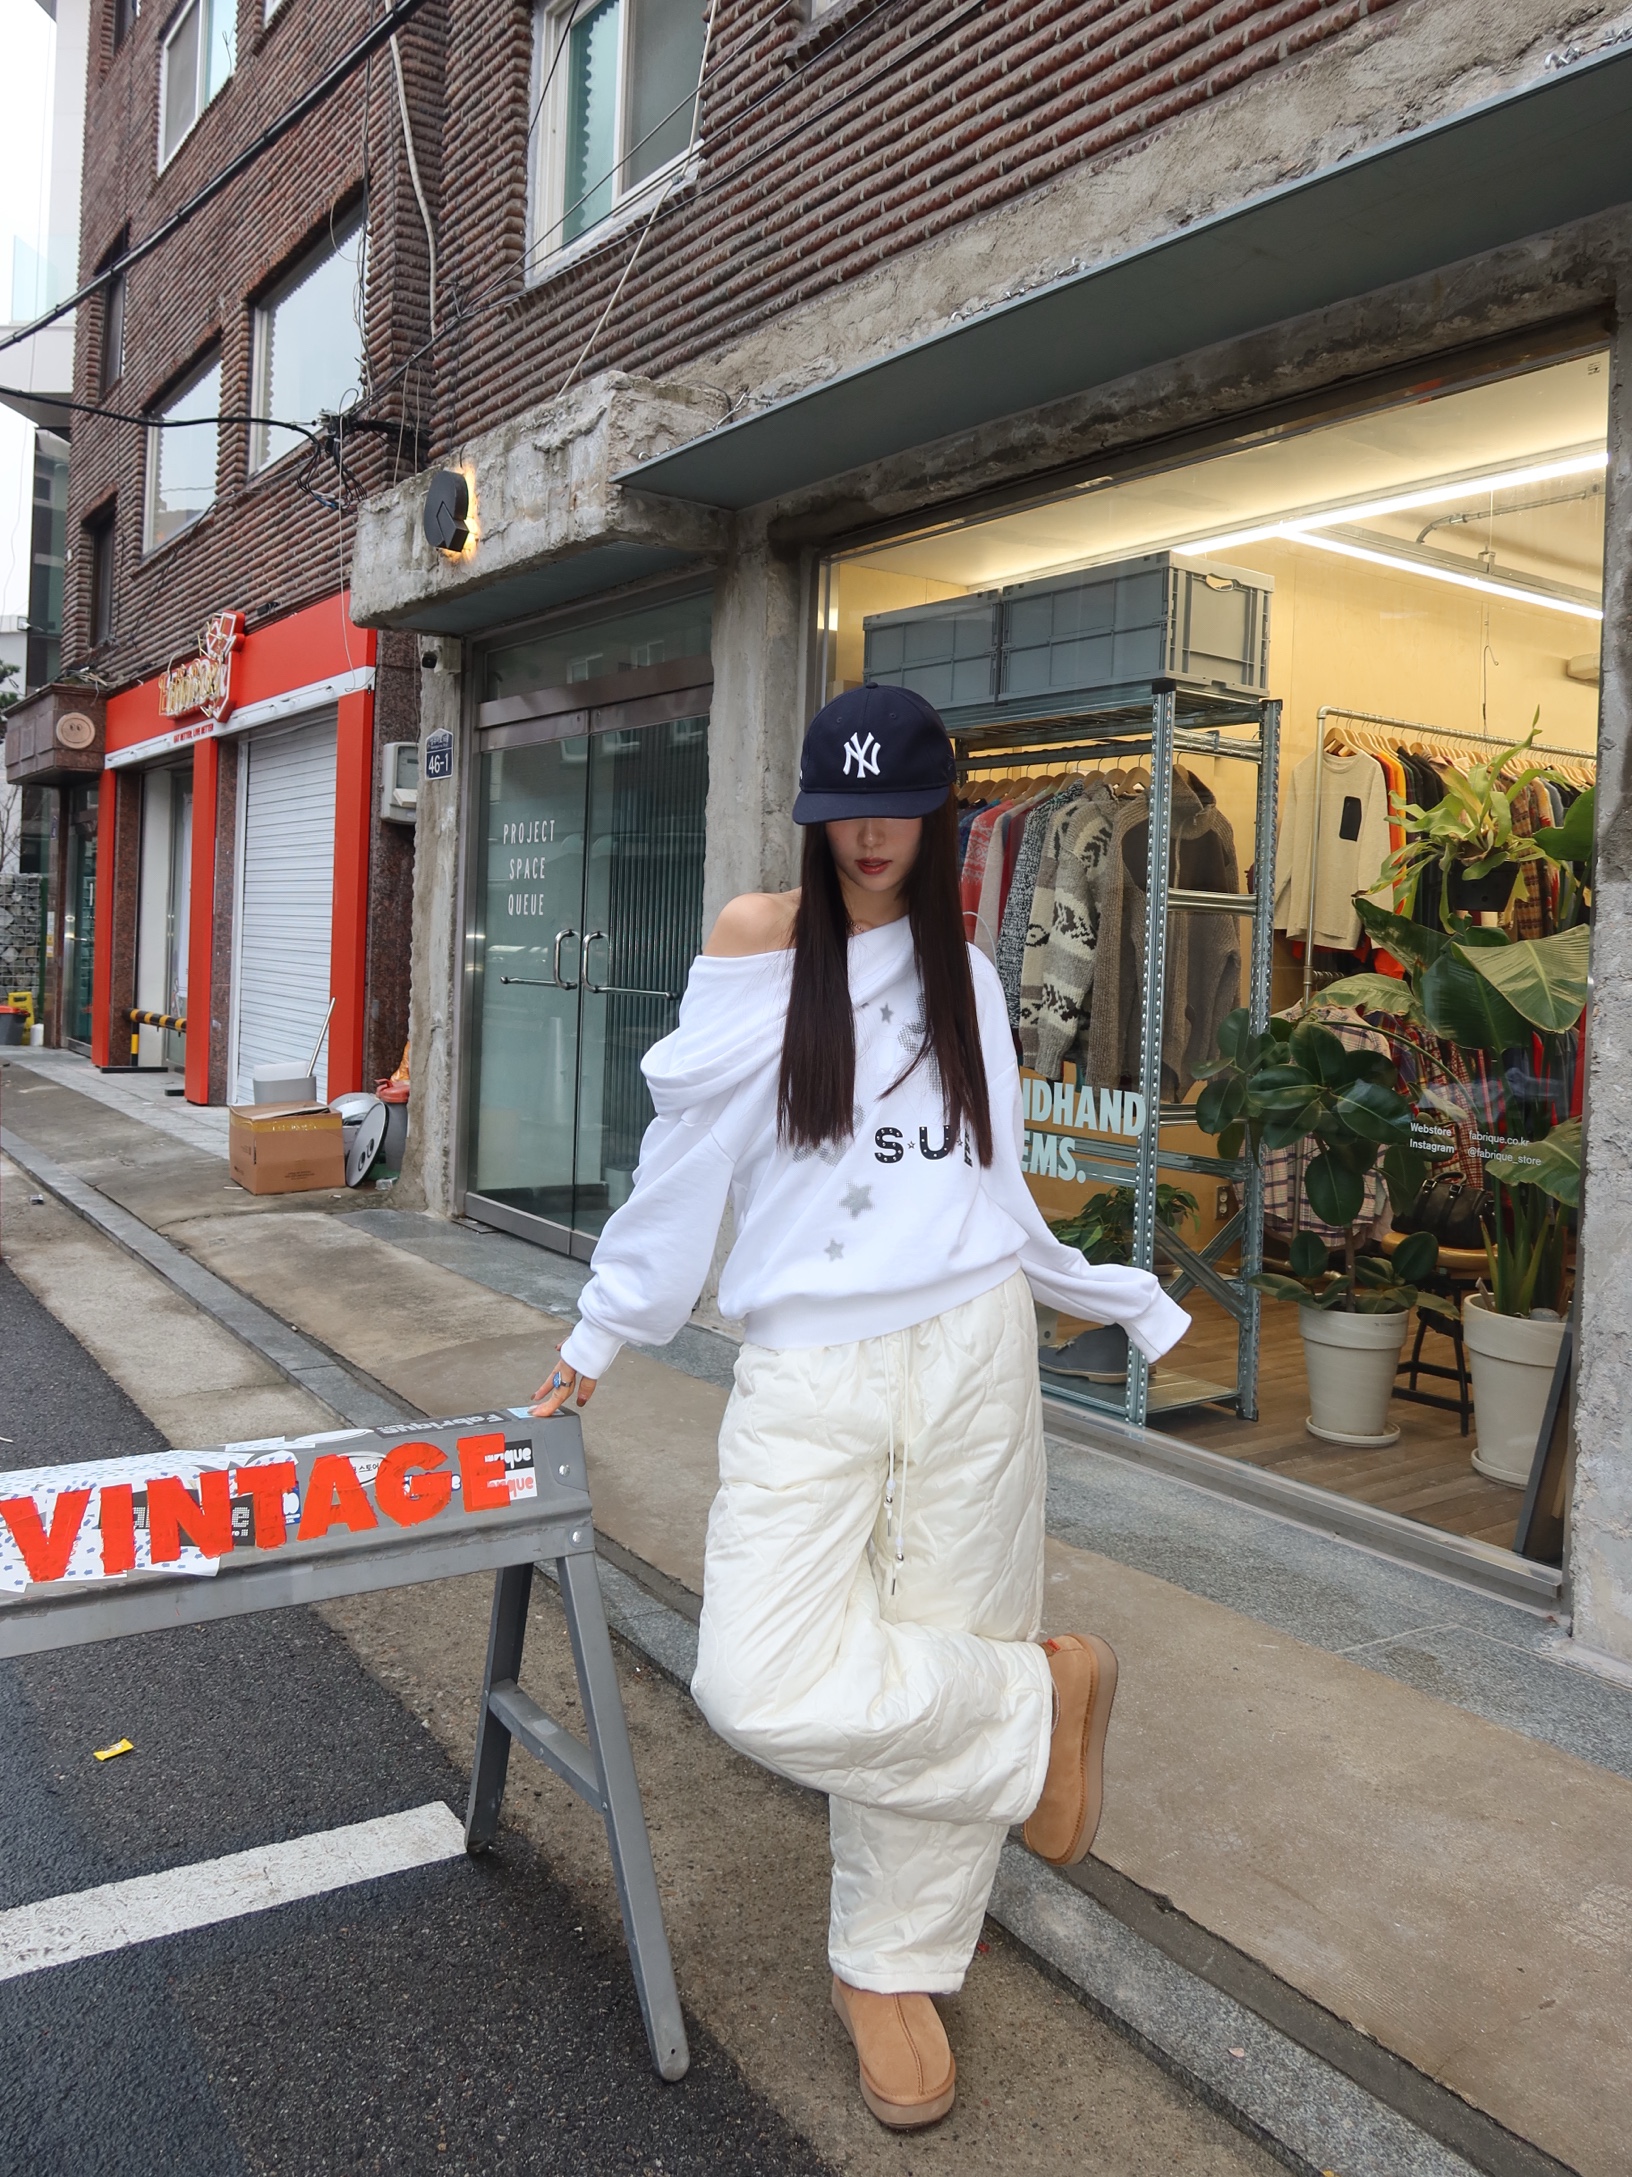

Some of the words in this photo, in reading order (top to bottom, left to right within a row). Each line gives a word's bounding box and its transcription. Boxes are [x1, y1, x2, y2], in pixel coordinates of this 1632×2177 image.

[428, 752, 449, 774] 46-1
[843, 732, 881, 778] NY
[503, 820, 555, 845] PROJECT
[509, 857, 546, 880] SPACE
[508, 893, 545, 916] QUEUE
[1410, 1122, 1452, 1137] Webstore
[1469, 1130, 1530, 1147] fabrique.co.kr
[1409, 1138, 1455, 1154] Instagram
[1467, 1147, 1542, 1166] @fabrique_store
[376, 1413, 504, 1434] Fabrique
[0, 1432, 511, 1583] VINTAGE
